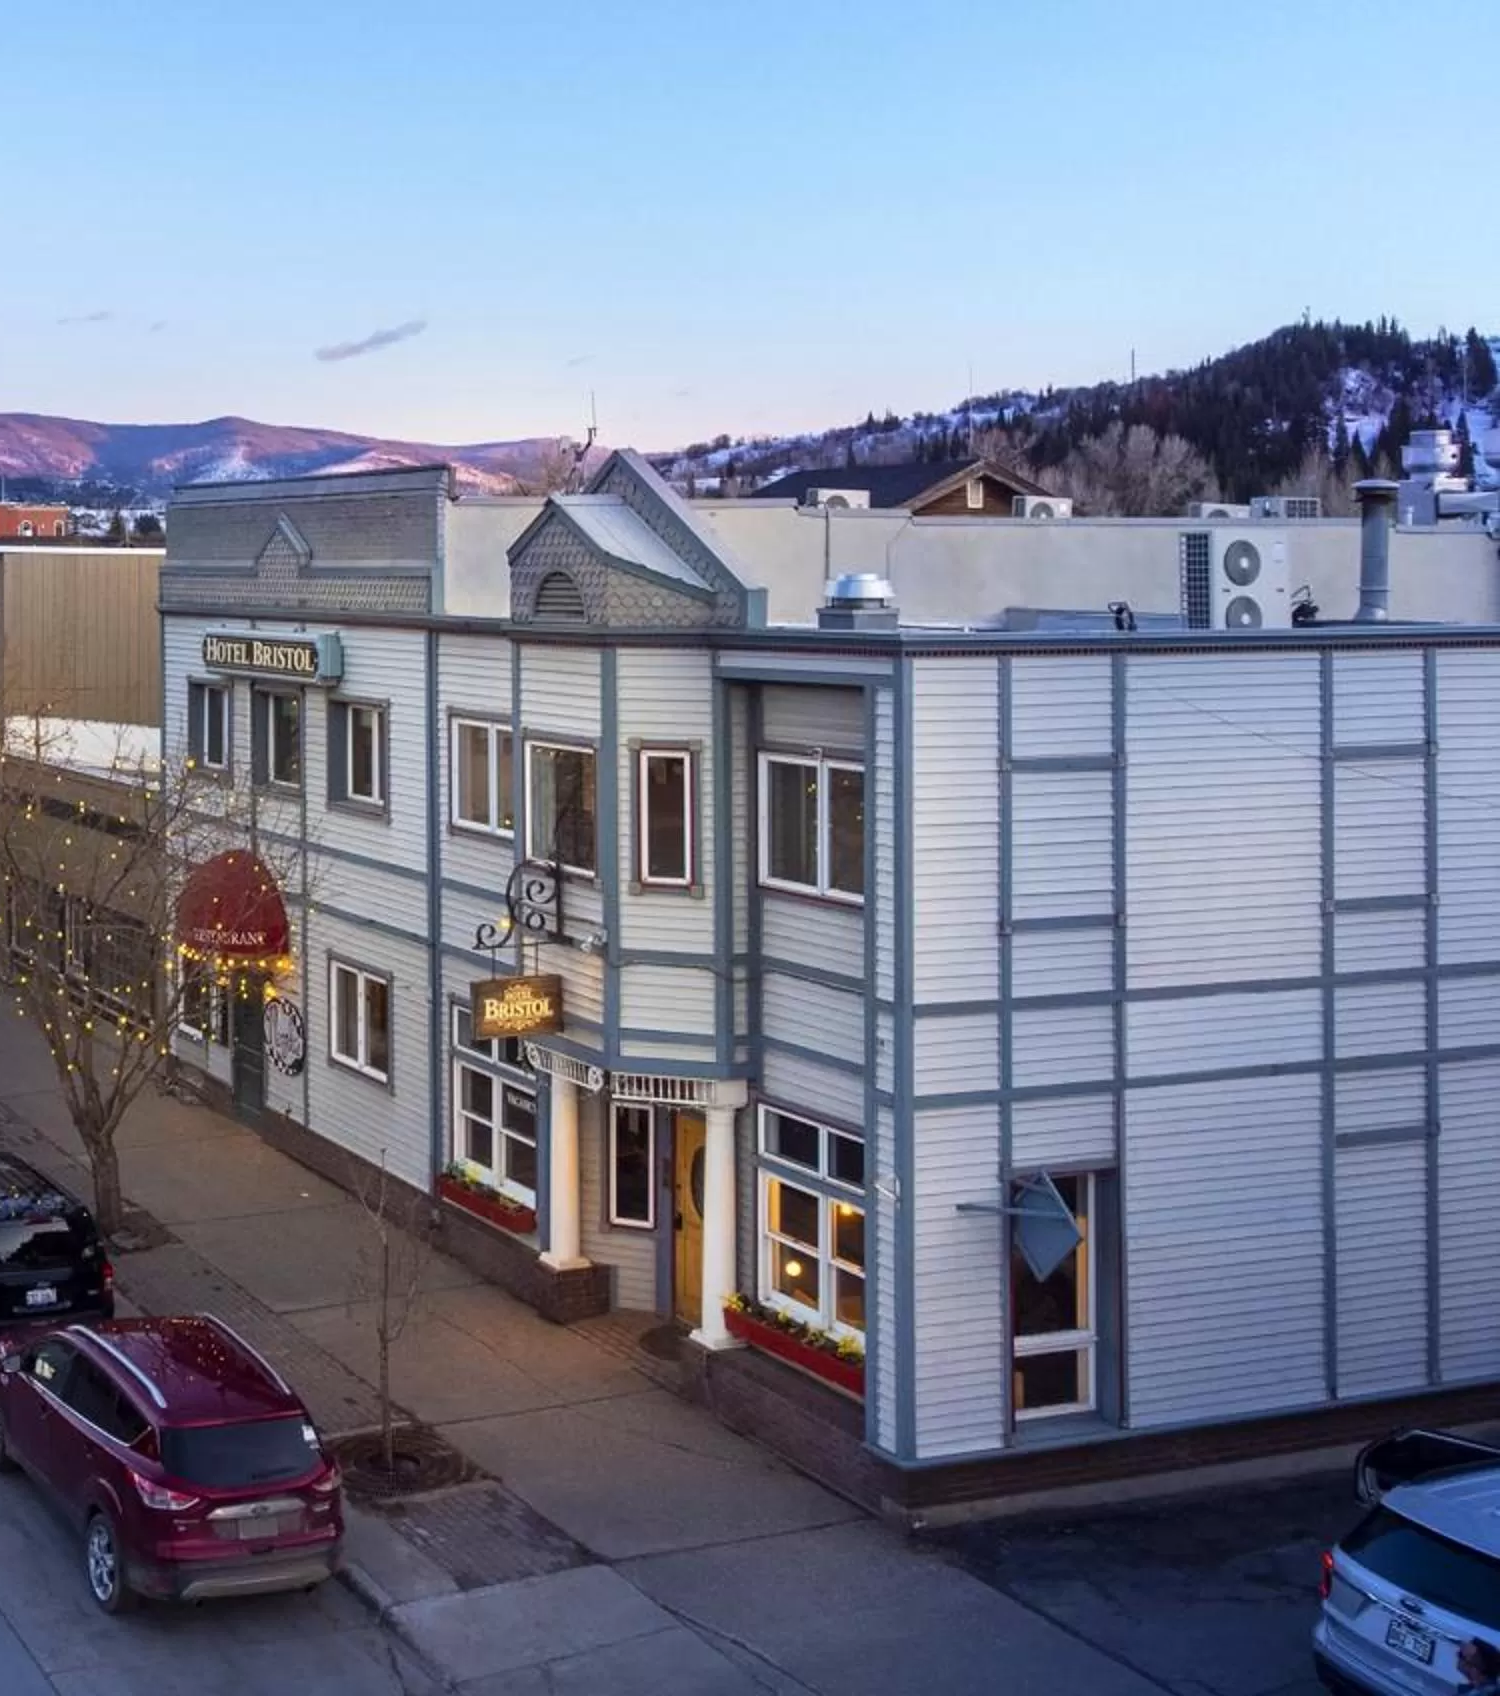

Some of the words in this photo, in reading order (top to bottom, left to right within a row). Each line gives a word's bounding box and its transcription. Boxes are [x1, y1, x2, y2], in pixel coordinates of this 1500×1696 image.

[206, 637, 250, 665] HOTEL
[252, 641, 315, 671] BRISTOL
[484, 998, 554, 1020] BRISTOL
